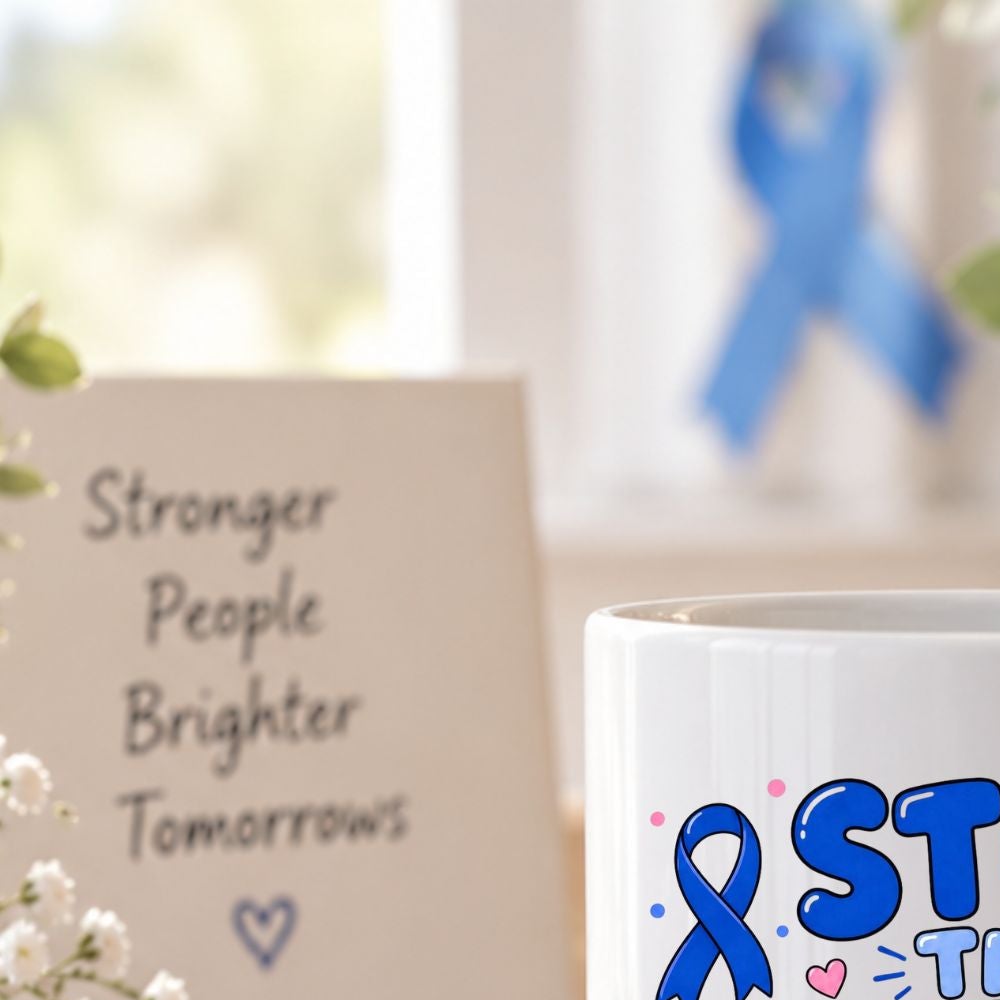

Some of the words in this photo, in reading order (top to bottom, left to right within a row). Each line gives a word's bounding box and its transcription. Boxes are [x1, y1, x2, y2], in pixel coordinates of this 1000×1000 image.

[83, 466, 338, 563] Stronger
[144, 565, 325, 666] People
[123, 672, 364, 779] Brighter
[115, 788, 410, 862] Tomorrows
